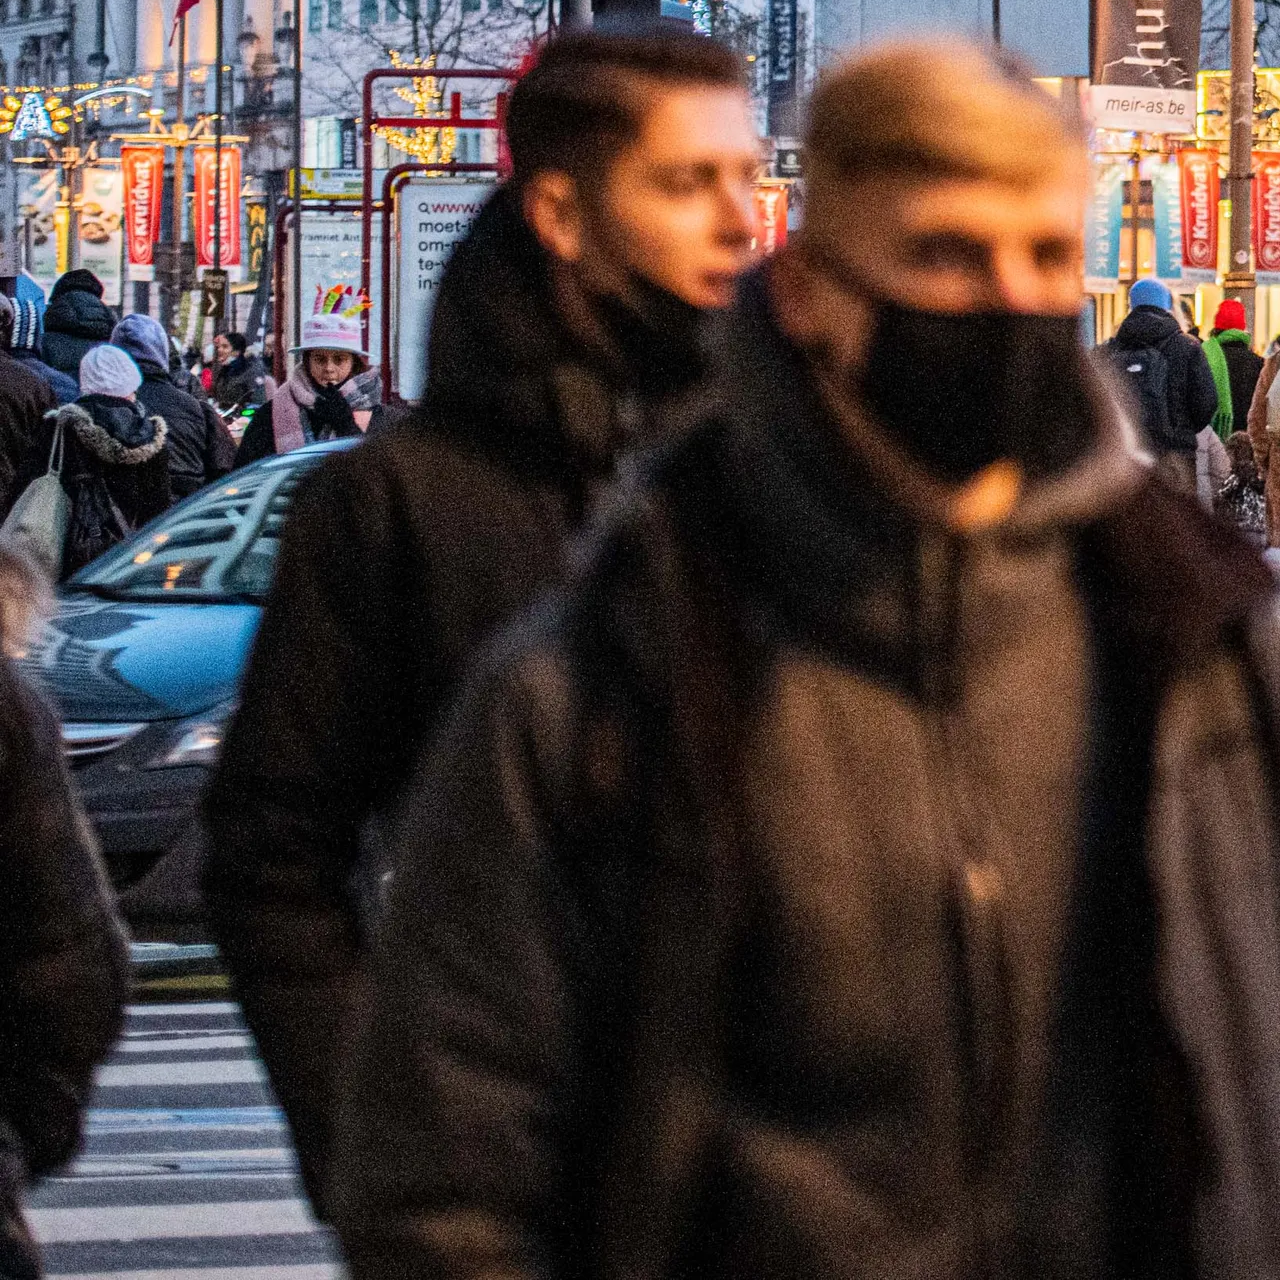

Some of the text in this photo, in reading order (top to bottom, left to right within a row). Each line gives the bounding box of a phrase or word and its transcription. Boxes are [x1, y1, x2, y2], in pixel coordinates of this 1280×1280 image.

[1105, 96, 1186, 116] meir-as.be
[134, 160, 151, 237] Kruidvat
[1192, 164, 1208, 240] Kruidvat
